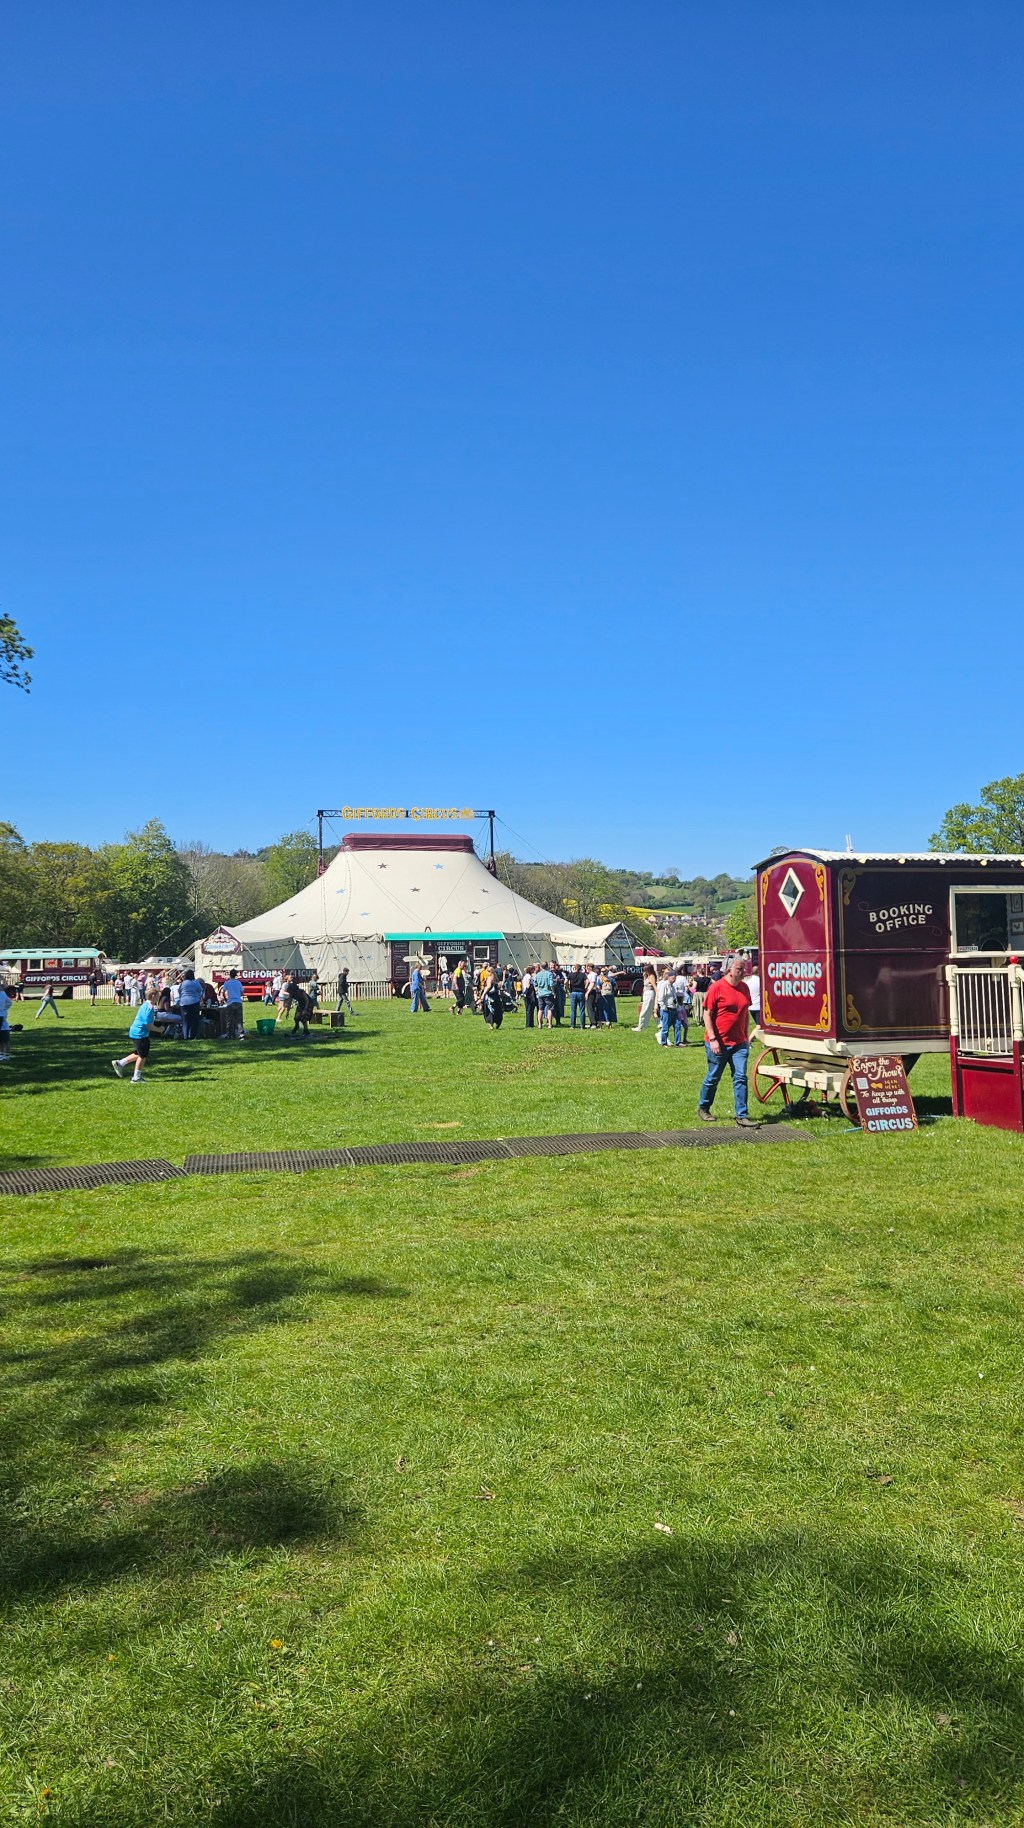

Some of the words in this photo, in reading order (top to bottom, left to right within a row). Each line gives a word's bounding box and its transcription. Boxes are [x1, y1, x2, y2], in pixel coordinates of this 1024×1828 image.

[342, 806, 405, 820] GIFFORDS
[411, 807, 457, 820] CIRCUS
[869, 904, 933, 922] BOOKING
[875, 915, 926, 932] OFFICE
[768, 962, 822, 979] GIFFORDS
[774, 980, 816, 997] CIRCUS
[853, 1057, 877, 1073] Enjoy
[878, 1057, 890, 1066] the
[871, 1090, 885, 1098] keep
[866, 1106, 908, 1116] GIFFORDS
[868, 1118, 913, 1131] CIRCUS
